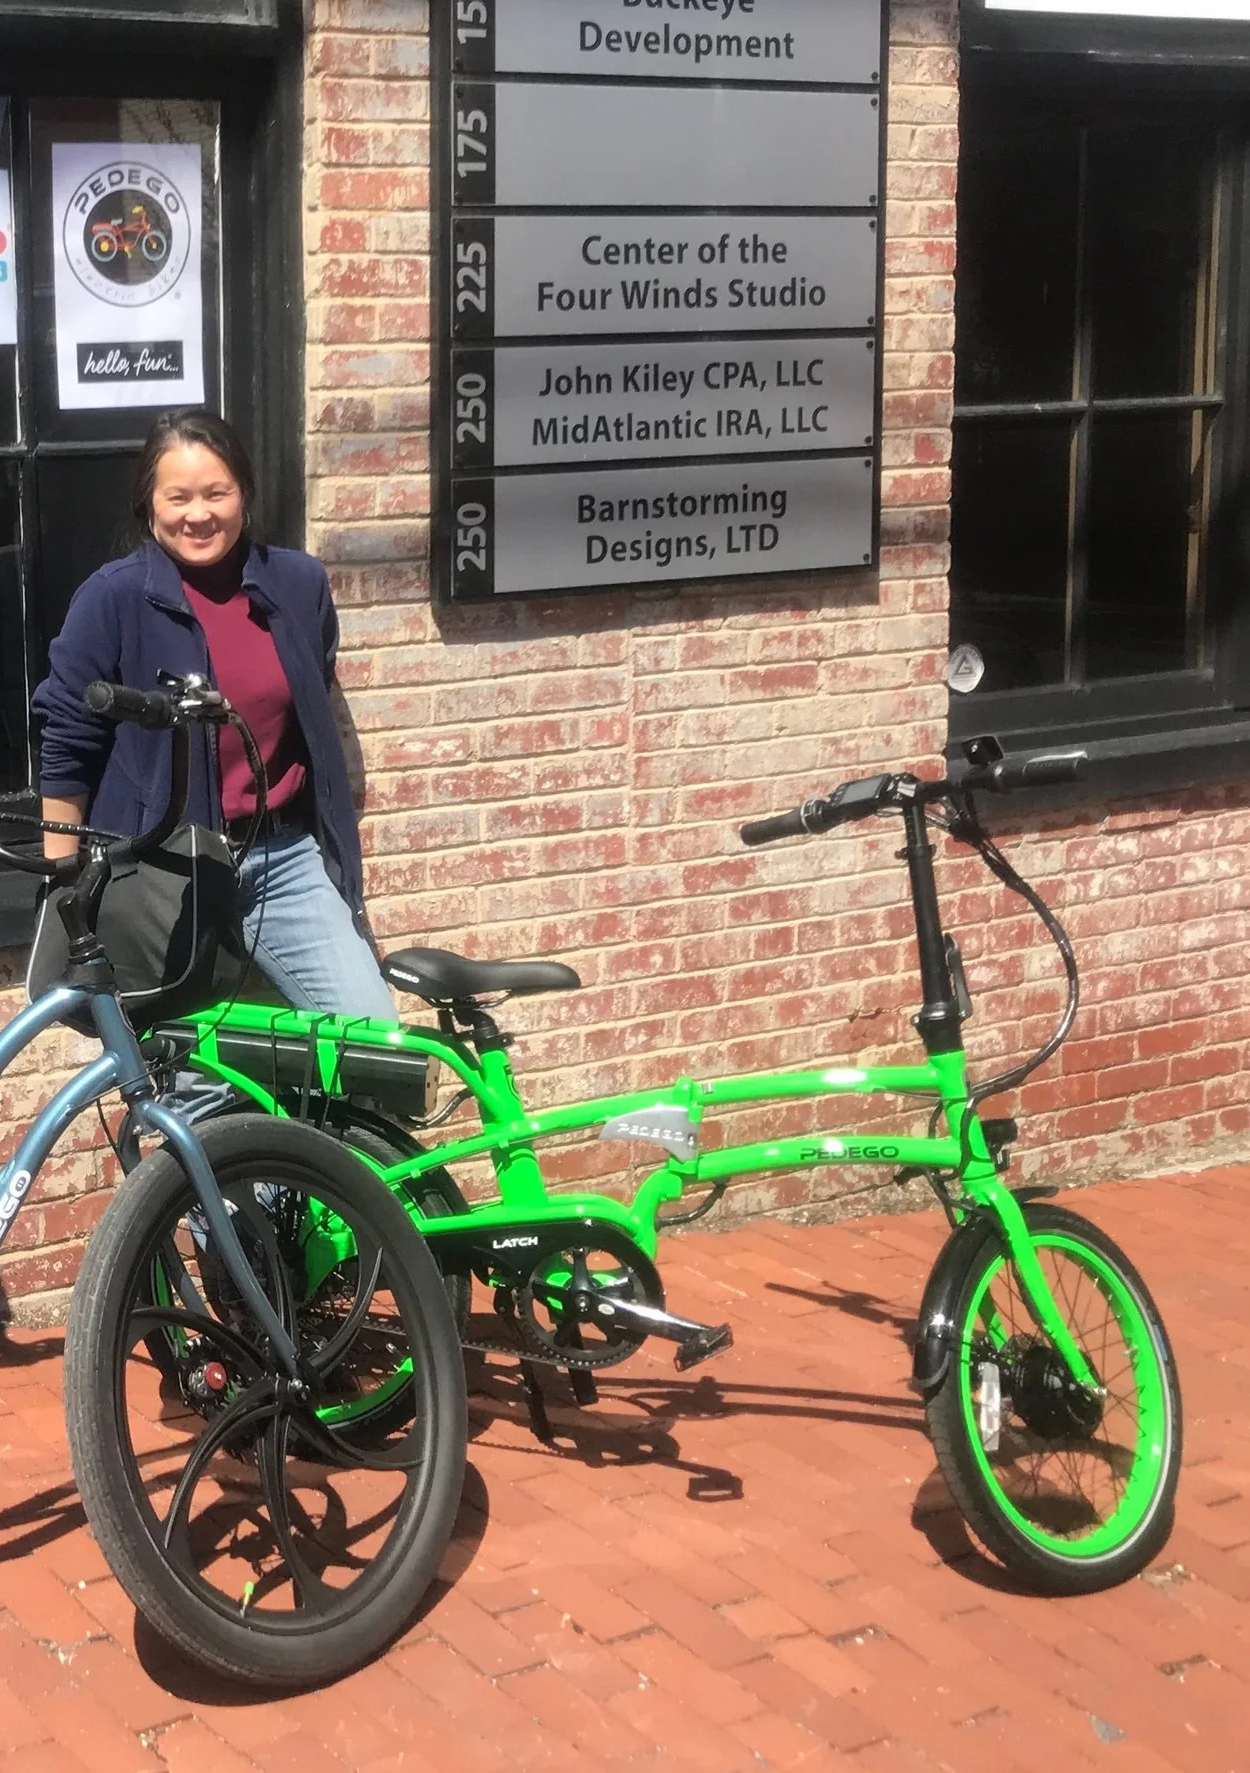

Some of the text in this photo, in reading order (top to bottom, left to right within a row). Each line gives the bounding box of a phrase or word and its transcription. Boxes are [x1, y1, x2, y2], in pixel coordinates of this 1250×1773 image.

[579, 21, 794, 63] Development
[456, 109, 488, 178] 175
[74, 168, 181, 215] PEDEGO
[581, 233, 788, 266] Center of the
[456, 242, 487, 313] 225
[537, 276, 826, 312] Four Winds Studio
[538, 358, 824, 398] John Kiley CPA, LLC
[456, 373, 487, 444] 250
[532, 405, 829, 446] MidAtlantic IRA, LLC
[577, 486, 787, 524] Barnstorming
[456, 502, 487, 572] 250
[586, 523, 779, 567] Designs, LTD
[800, 1145, 900, 1161] PEDEGO
[492, 1236, 539, 1249] LATCH
